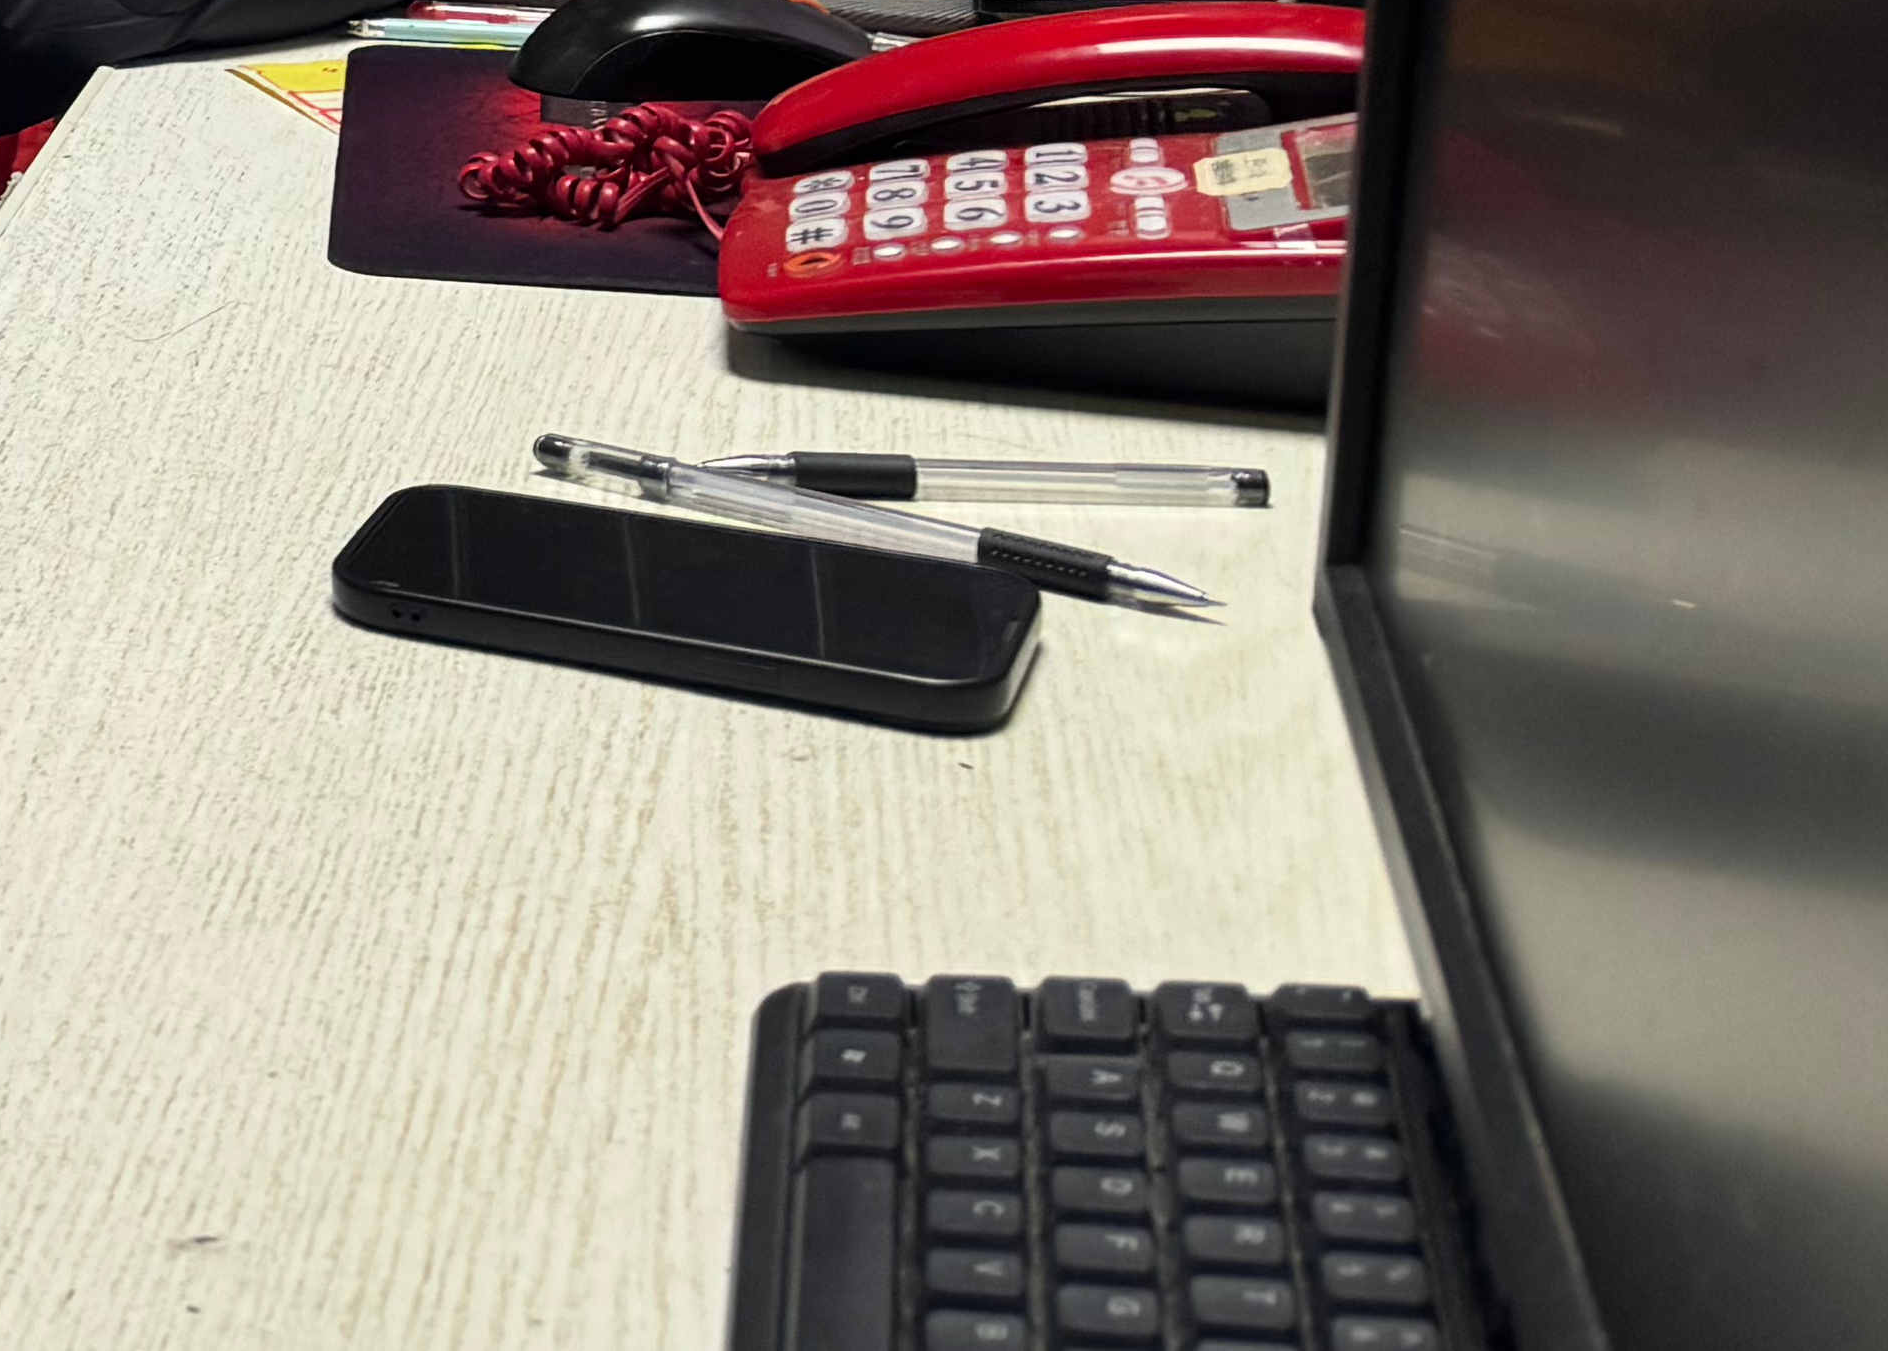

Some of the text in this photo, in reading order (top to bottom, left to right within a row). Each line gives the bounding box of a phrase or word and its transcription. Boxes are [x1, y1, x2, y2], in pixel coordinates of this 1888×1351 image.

[1033, 170, 1080, 184] 2
[953, 179, 999, 192] 5
[872, 187, 916, 202] 8
[794, 198, 837, 215] 0
[956, 206, 1005, 222] 6
[1033, 200, 1081, 214] 3
[870, 215, 914, 230] 9
[972, 1092, 1002, 1107] Z
[1094, 1121, 1127, 1137] S
[972, 1199, 1005, 1217] C
